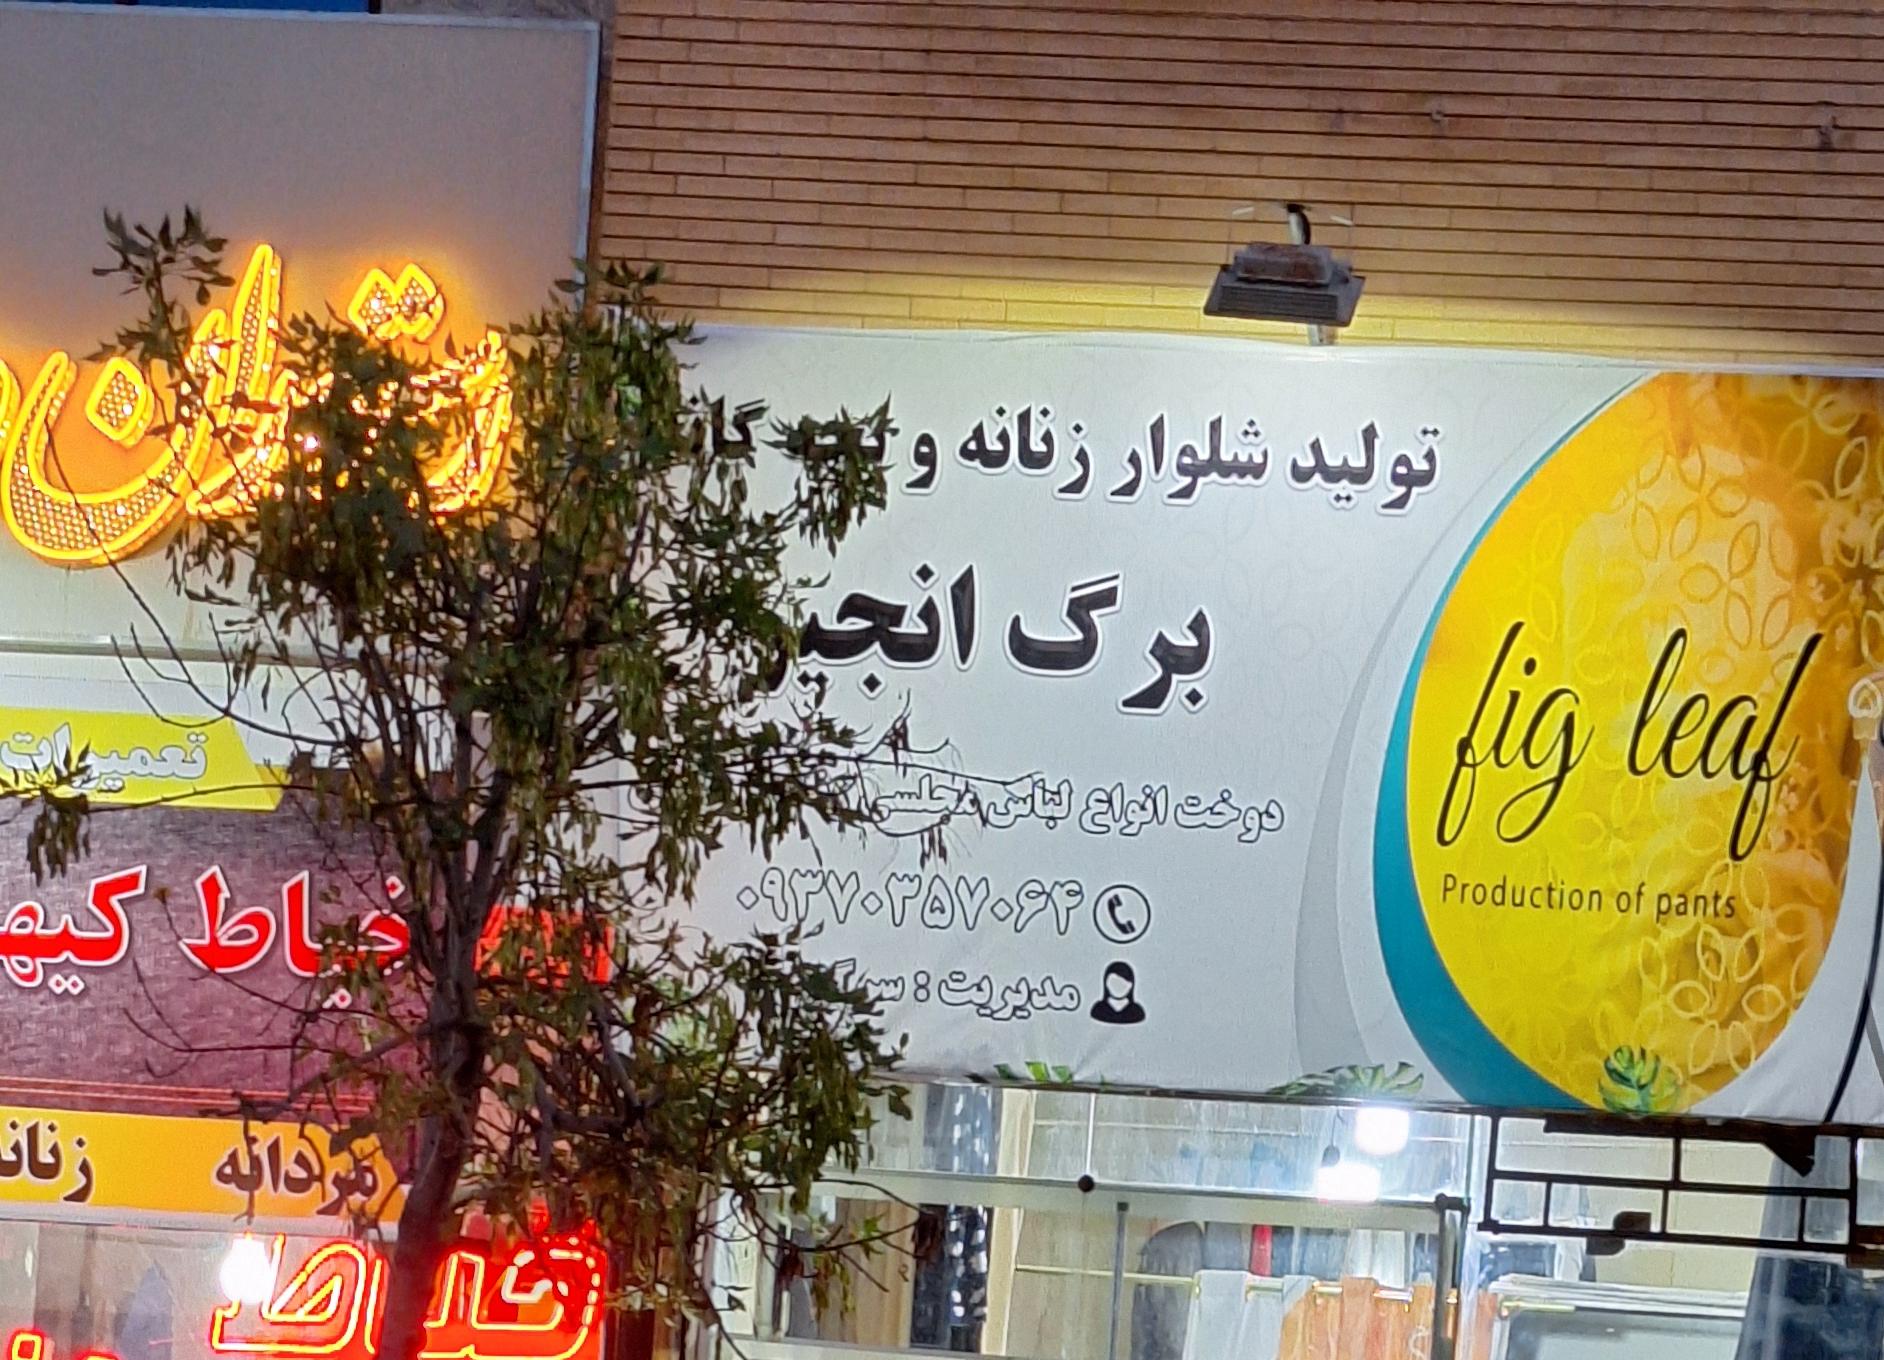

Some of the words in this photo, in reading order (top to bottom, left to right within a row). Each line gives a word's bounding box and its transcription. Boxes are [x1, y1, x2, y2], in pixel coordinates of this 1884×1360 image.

[906, 432, 938, 489] و
[959, 403, 1091, 494] زنانه
[1110, 413, 1269, 500] شلوار
[1290, 420, 1441, 509] تولید
[1009, 573, 1211, 709] برگ
[1, 722, 207, 791] تعمیرات
[1436, 621, 1594, 847] fig
[1627, 628, 1824, 862] leaf
[985, 778, 1072, 829] لباس
[1079, 782, 1169, 837] انواع
[1174, 788, 1285, 843] دوخت
[0, 864, 148, 995] کیه
[736, 866, 1085, 936] ۰۹۳۷۰۳۵۷۰۶۴
[1441, 873, 1603, 912] Production
[1615, 882, 1646, 915] of
[1655, 889, 1737, 924] pants
[937, 970, 1081, 1021] مدیریت
[0, 1119, 94, 1204] زنان
[216, 1135, 378, 1216] مردانه
